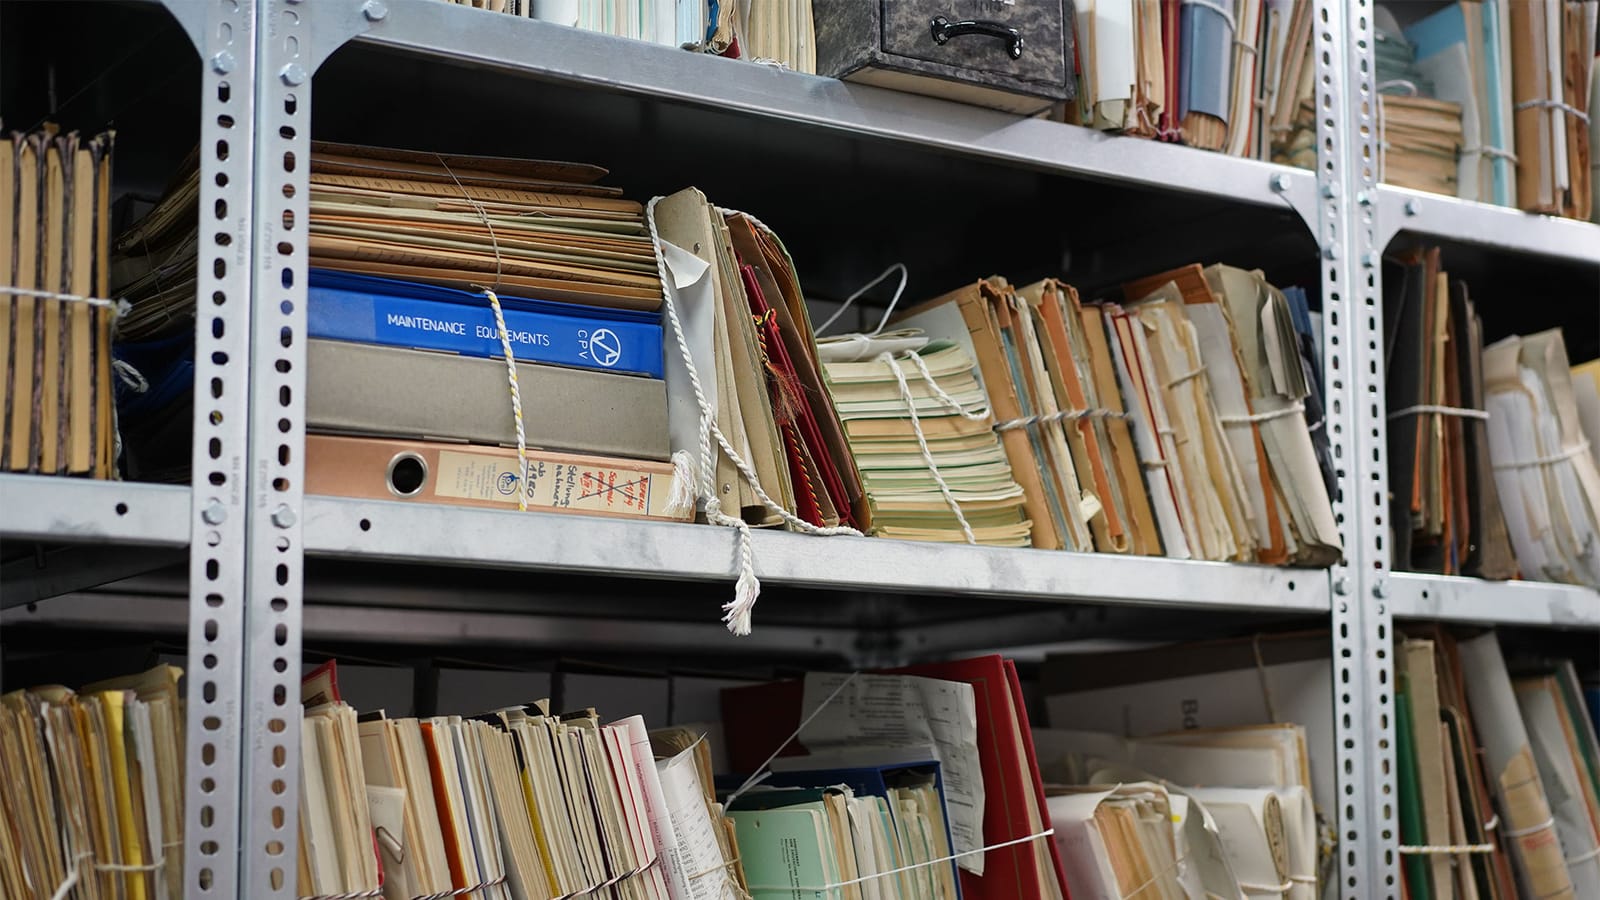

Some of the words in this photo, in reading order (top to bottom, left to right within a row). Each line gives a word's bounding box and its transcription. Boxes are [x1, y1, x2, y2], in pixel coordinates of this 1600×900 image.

[387, 313, 466, 335] MAINTENANCE
[476, 325, 550, 347] EQUIEMENTS
[576, 329, 589, 359] CPV
[538, 461, 546, 477] ab
